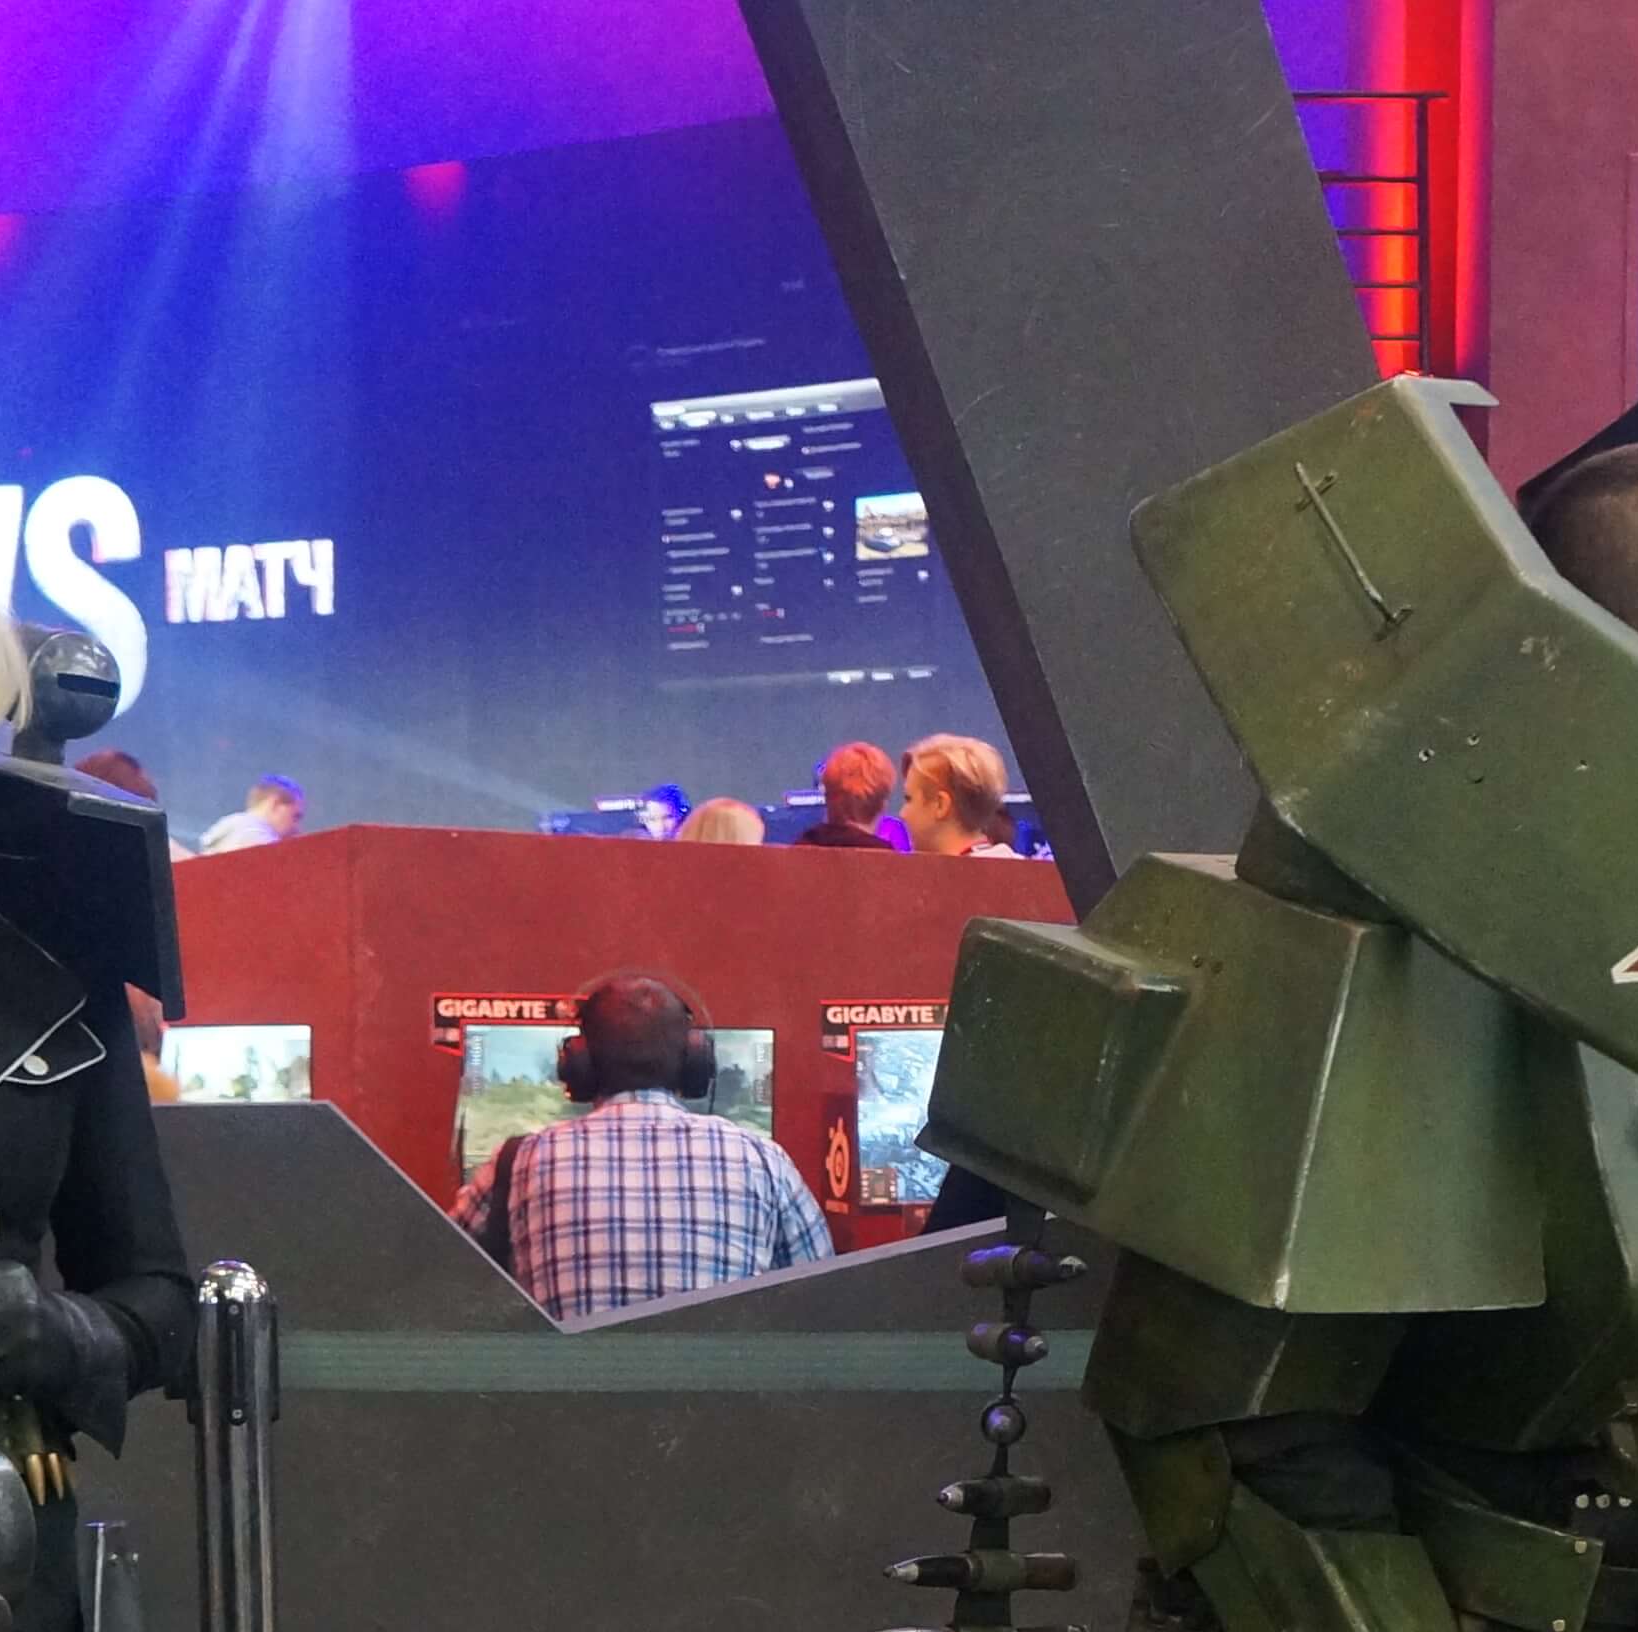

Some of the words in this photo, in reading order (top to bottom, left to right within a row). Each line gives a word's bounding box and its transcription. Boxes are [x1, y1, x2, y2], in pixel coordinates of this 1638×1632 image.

[164, 538, 335, 624] МАТЧ
[436, 998, 547, 1019] GIGABYTE
[826, 1005, 934, 1024] GIGABYTE
